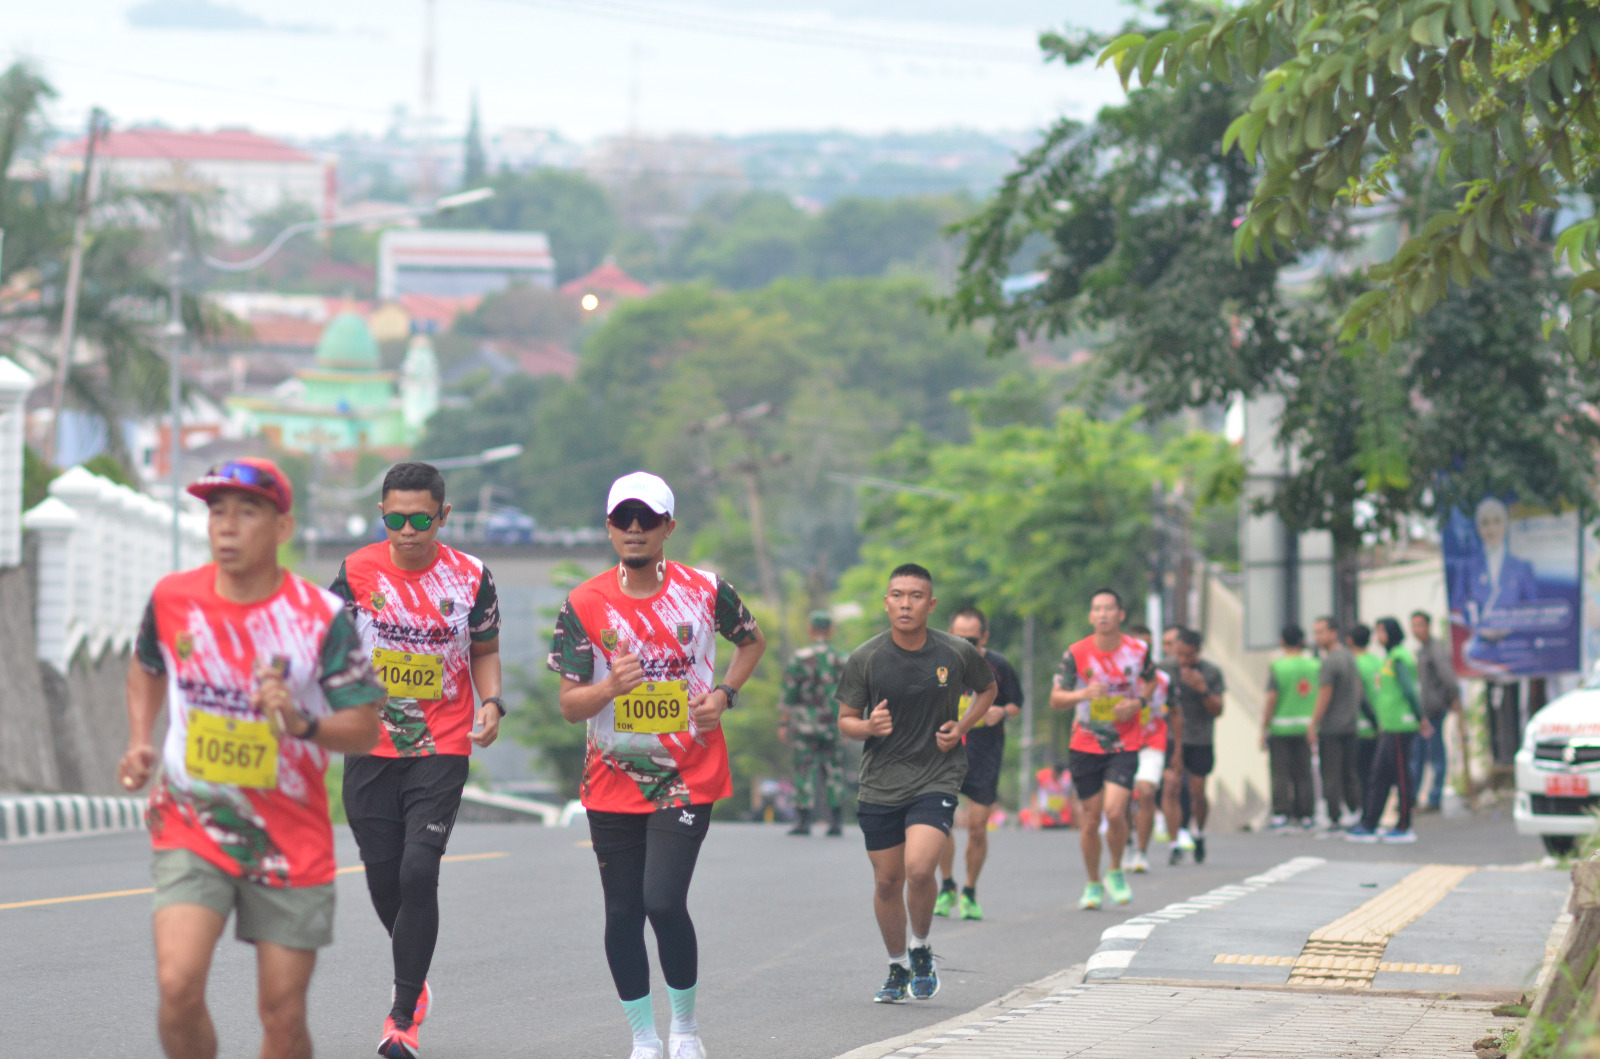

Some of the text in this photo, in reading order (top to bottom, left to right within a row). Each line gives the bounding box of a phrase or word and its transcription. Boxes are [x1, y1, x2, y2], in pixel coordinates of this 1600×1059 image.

[372, 618, 459, 638] SRIWIJAYA
[378, 632, 426, 645] LAMPUNG
[381, 664, 435, 687] 10402
[622, 698, 680, 720] 10069
[616, 722, 634, 730] 10K
[195, 735, 267, 769] 10567
